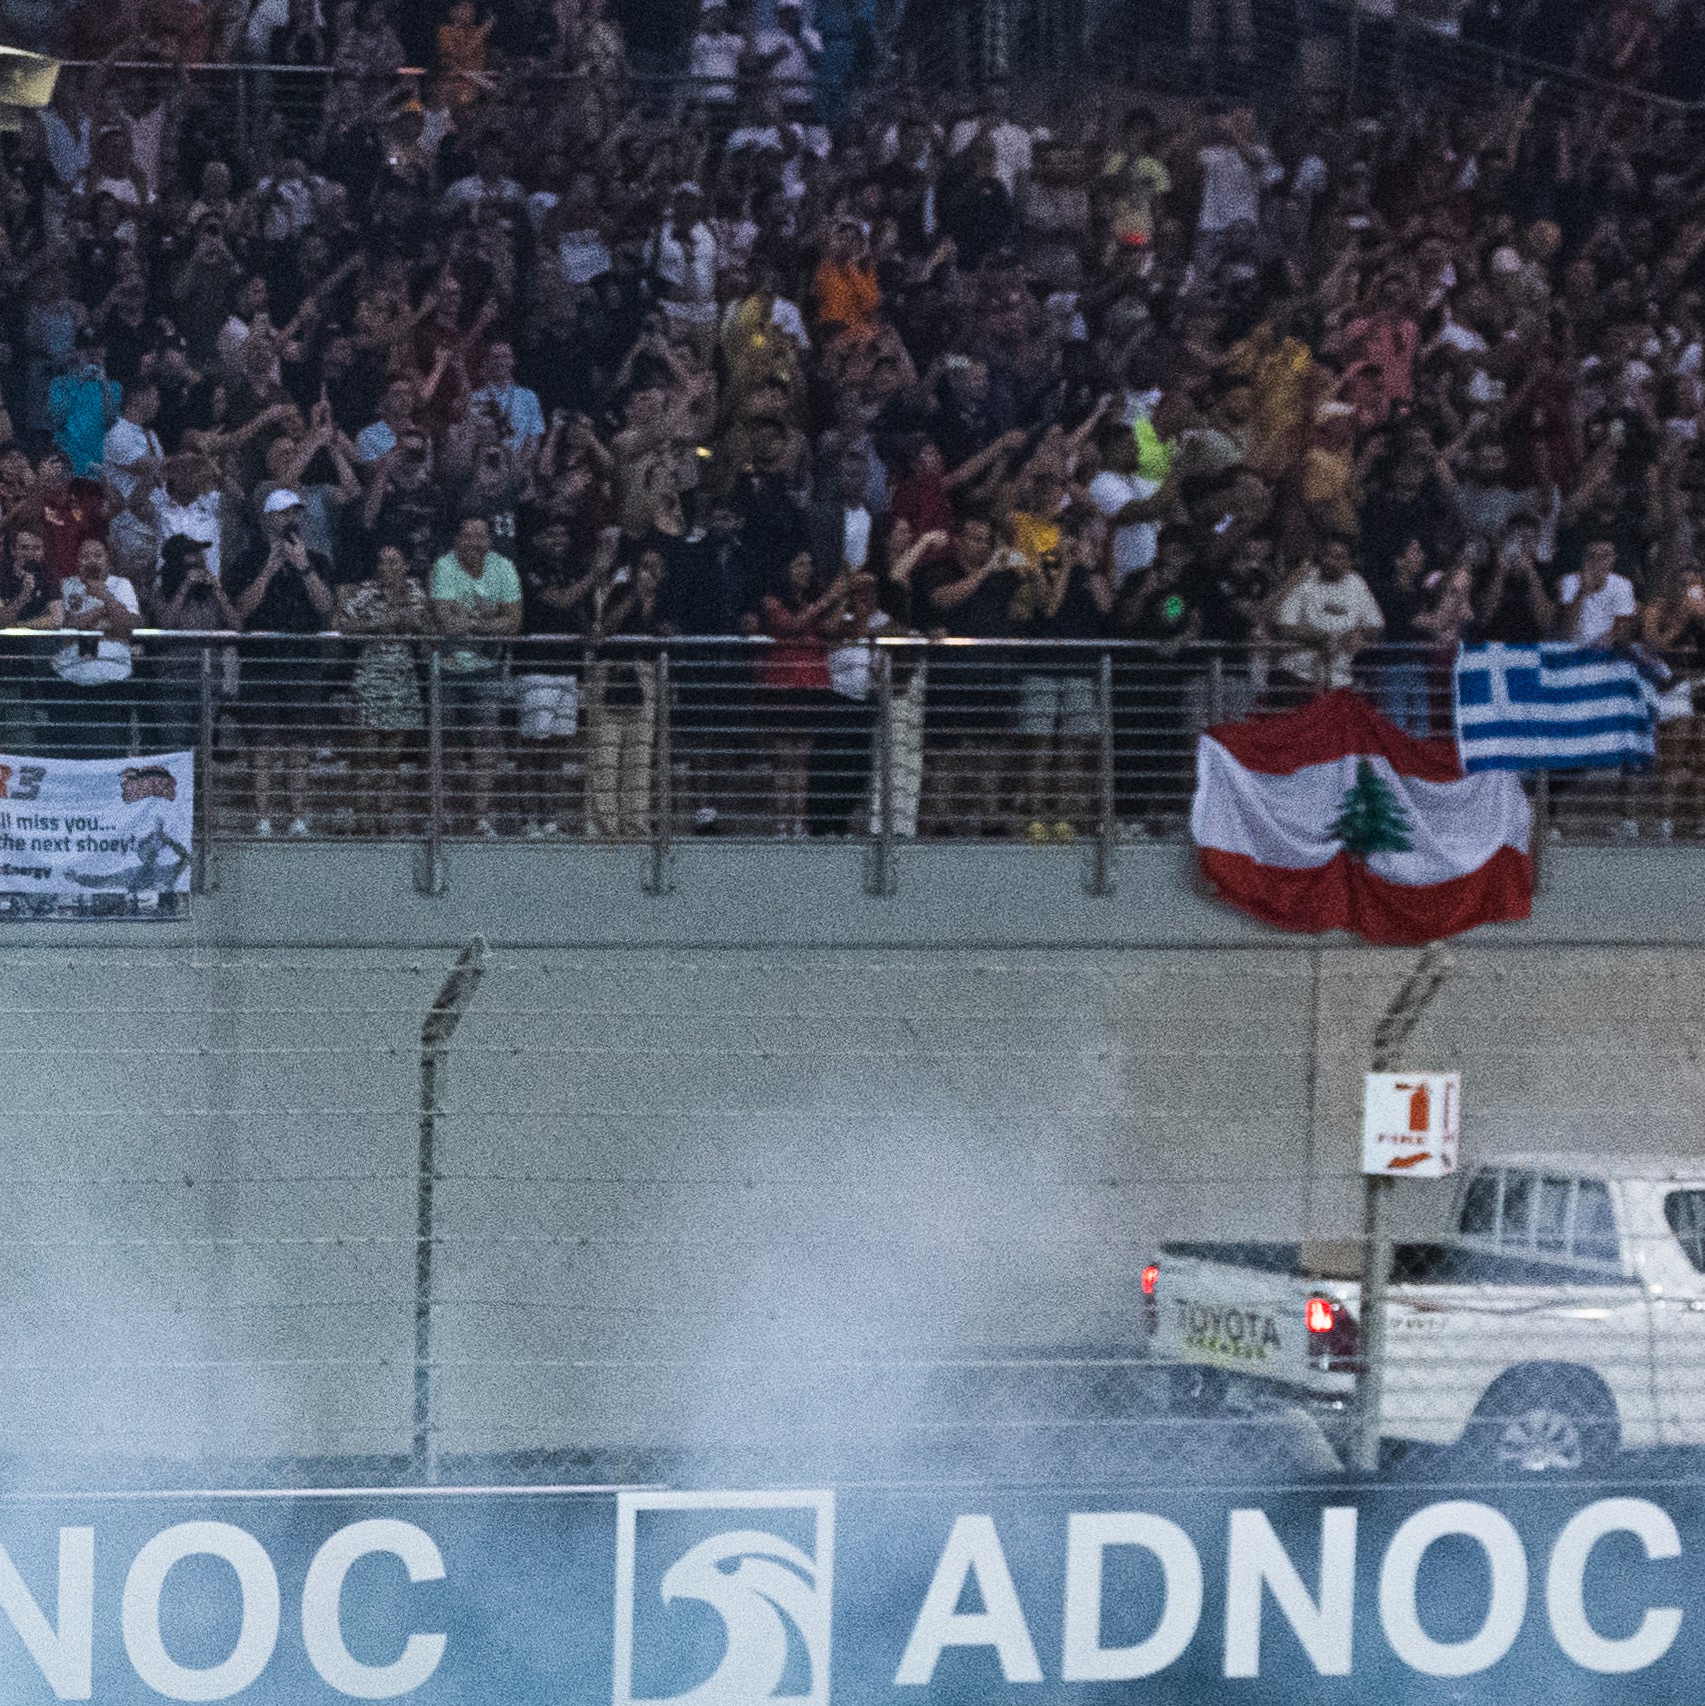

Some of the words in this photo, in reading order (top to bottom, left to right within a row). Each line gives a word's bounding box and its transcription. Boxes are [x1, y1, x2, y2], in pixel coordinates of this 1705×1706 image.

[16, 813, 60, 831] miss
[30, 835, 72, 851] next
[893, 1497, 1683, 1686] ADNOC
